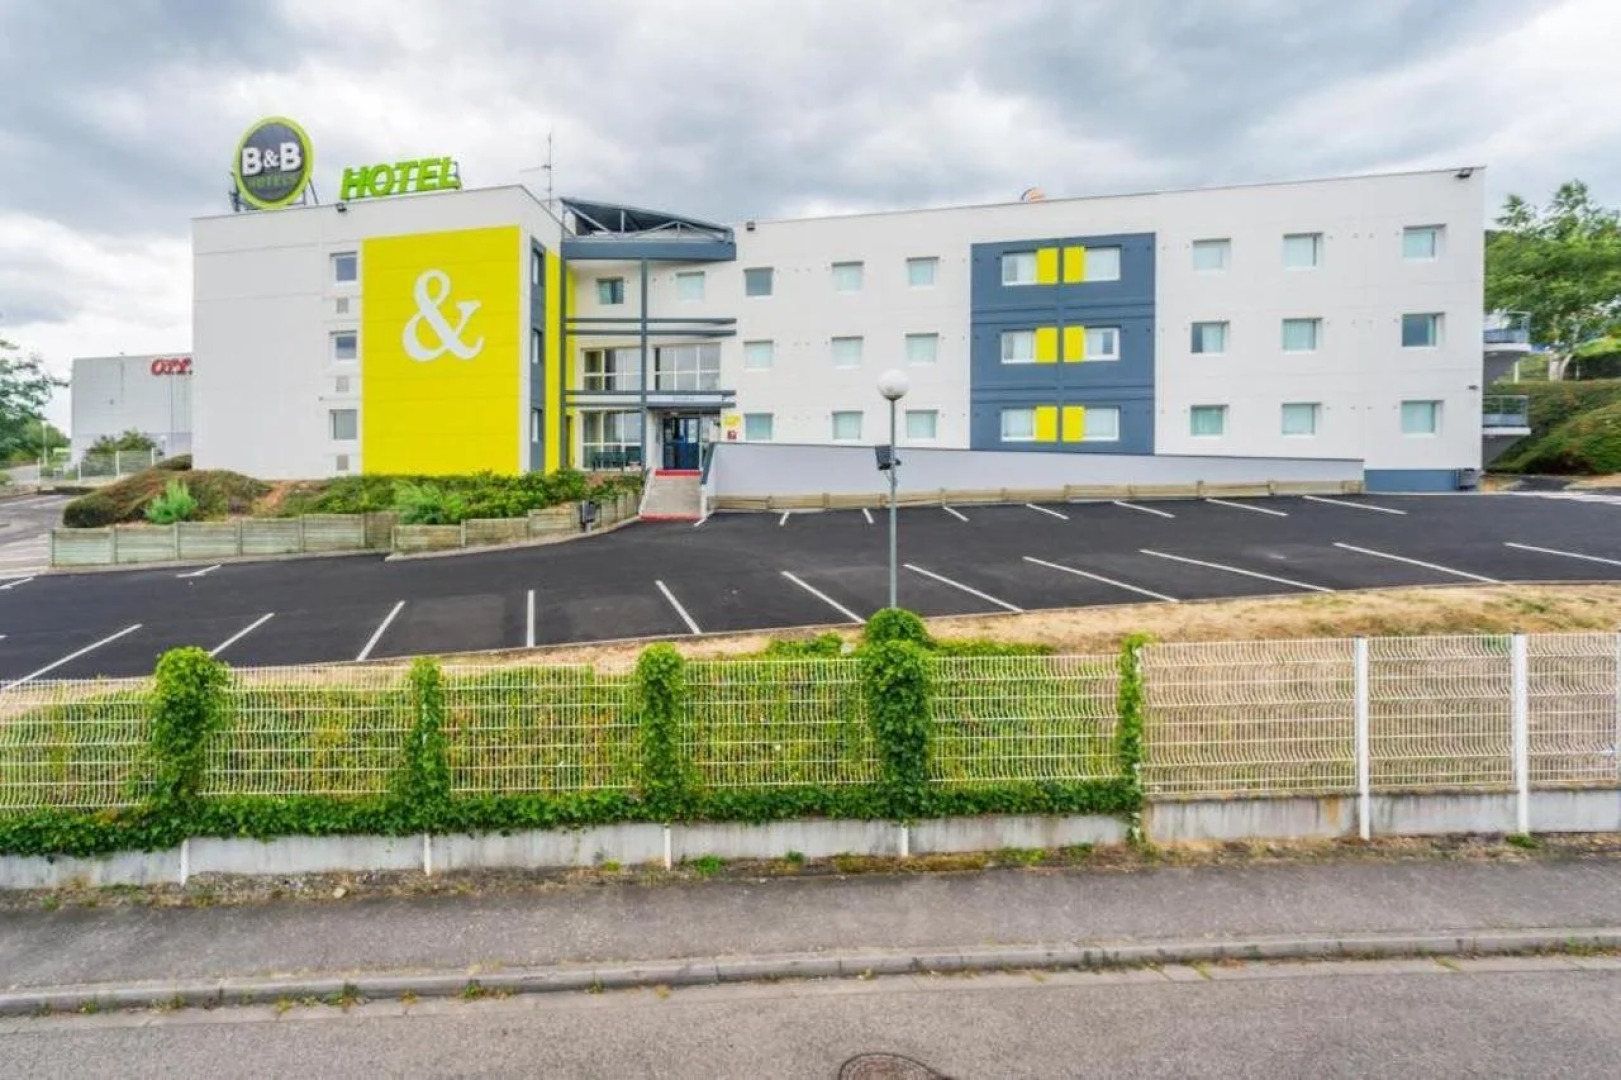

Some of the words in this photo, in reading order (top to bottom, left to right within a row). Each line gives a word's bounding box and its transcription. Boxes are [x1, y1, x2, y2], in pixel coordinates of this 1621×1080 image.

[241, 142, 302, 176] B&B
[340, 156, 459, 200] HOTEL
[403, 269, 485, 361] &
